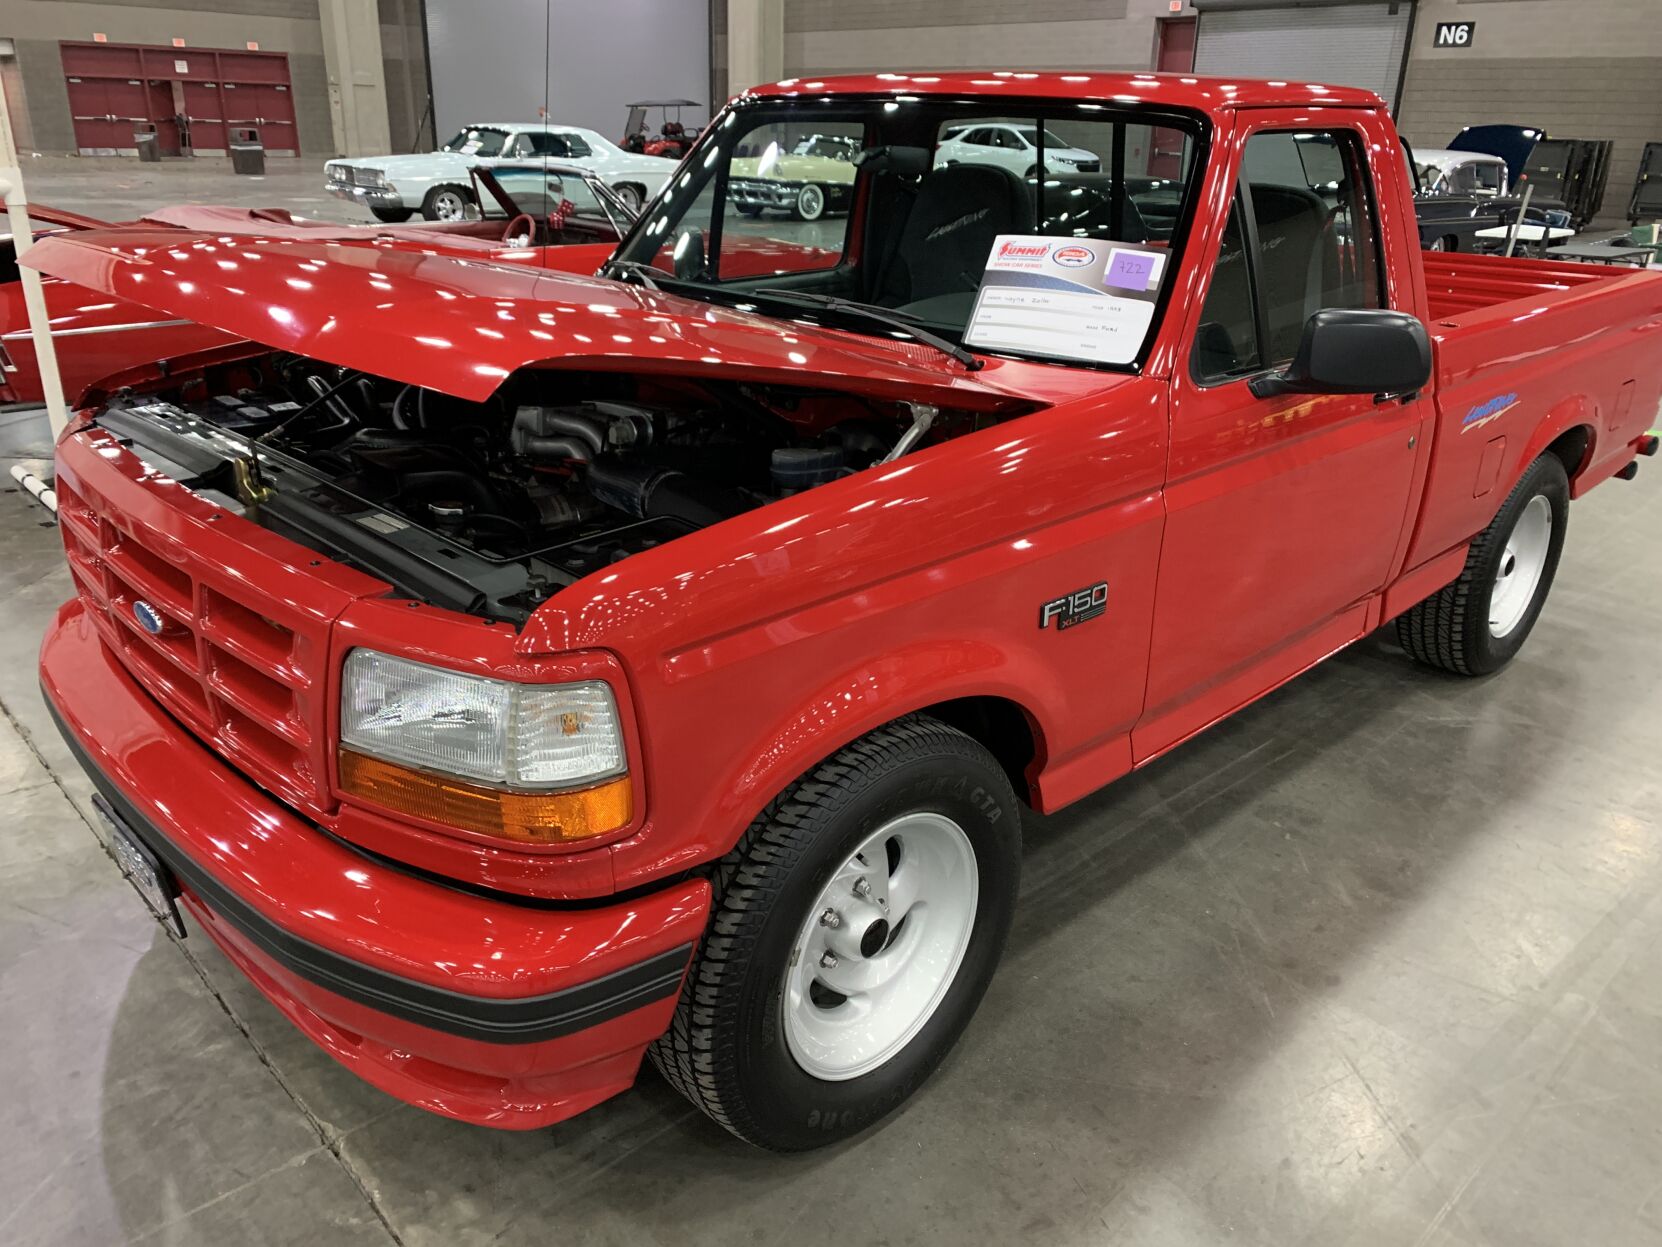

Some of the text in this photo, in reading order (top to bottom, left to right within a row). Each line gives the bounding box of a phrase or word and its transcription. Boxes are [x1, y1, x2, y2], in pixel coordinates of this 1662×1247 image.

[1439, 24, 1469, 44] N6
[998, 240, 1050, 258] SUMMIT
[1120, 261, 1146, 275] 722
[1062, 614, 1080, 628] XLT
